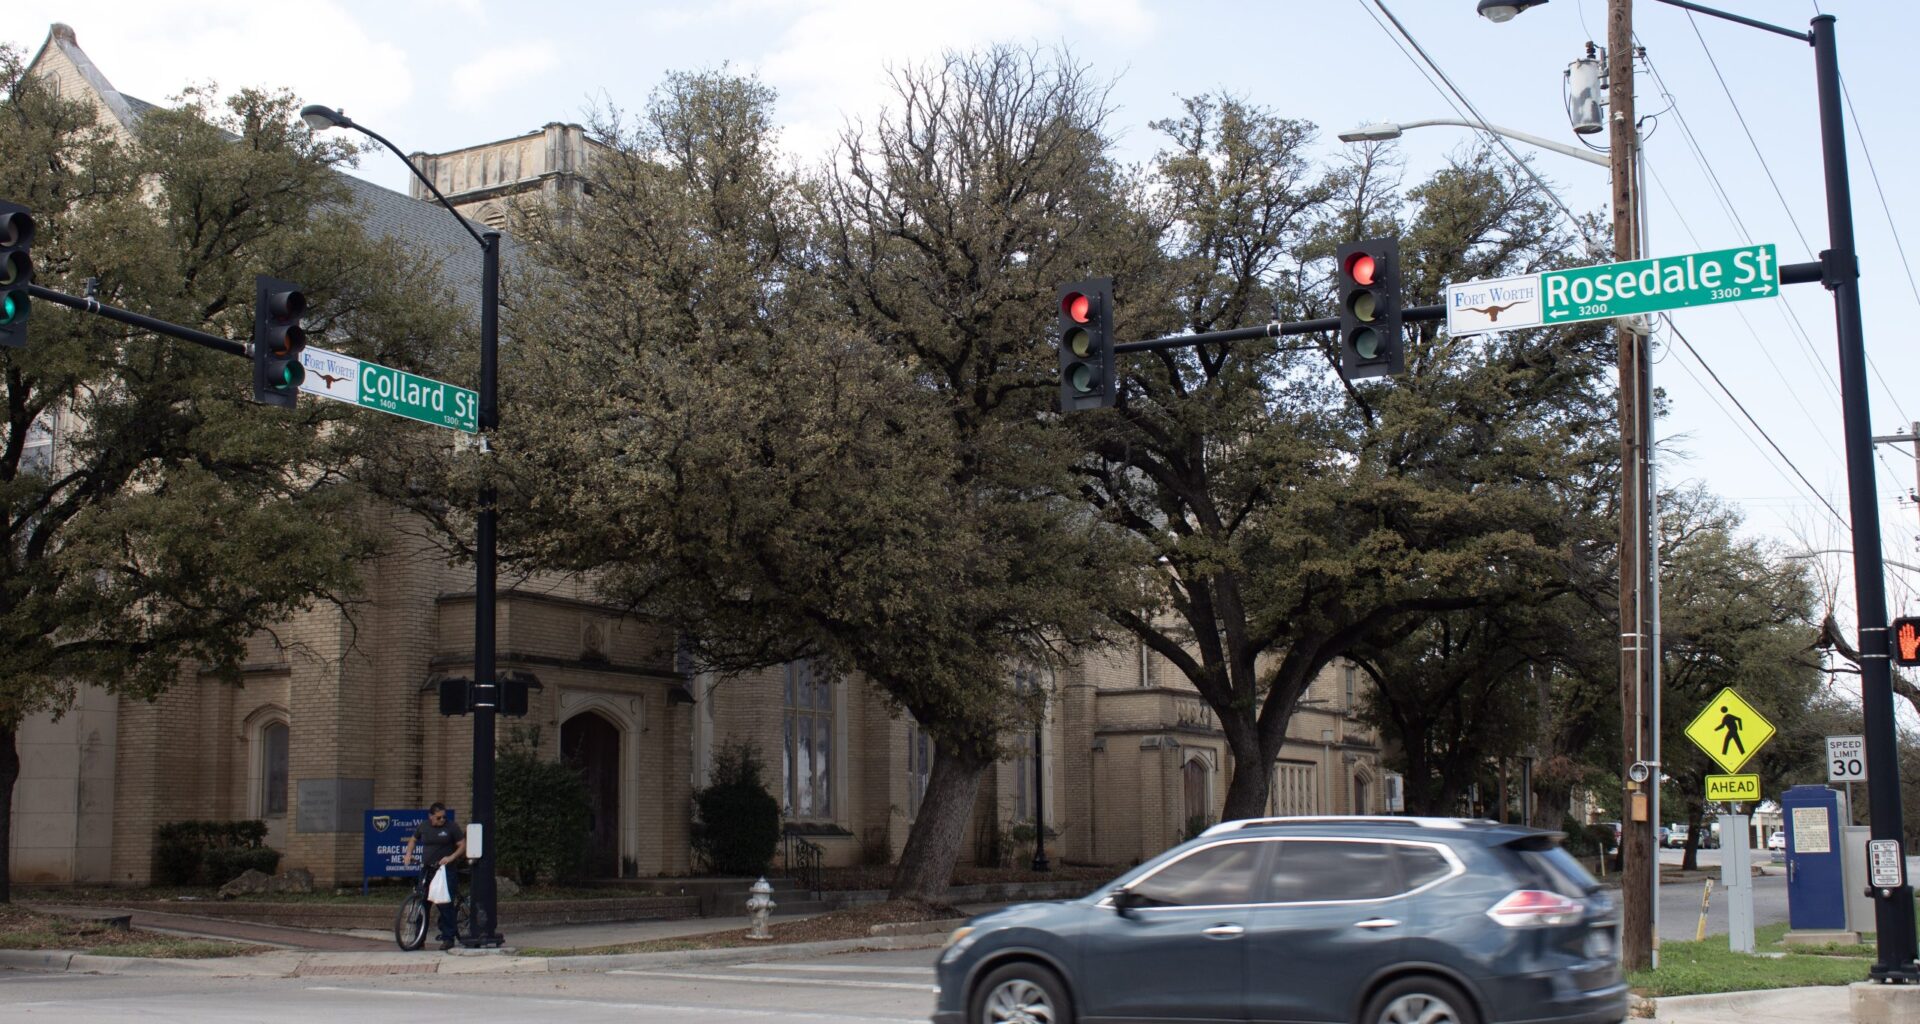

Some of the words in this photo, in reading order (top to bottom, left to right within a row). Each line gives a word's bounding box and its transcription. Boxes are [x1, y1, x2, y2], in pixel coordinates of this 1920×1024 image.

[1547, 256, 1722, 307] Rosedale
[1734, 246, 1774, 285] St
[1455, 292, 1486, 307] FORT
[1489, 287, 1534, 302] WORTH
[1711, 286, 1741, 300] 3300
[1578, 303, 1607, 316] 3200
[304, 353, 324, 371] FORT
[327, 359, 355, 379] WORTH
[363, 367, 444, 412] Collard
[455, 391, 475, 421] St
[380, 399, 397, 410] 1400
[444, 415, 459, 426] 1300
[1830, 740, 1861, 748] SPEED
[1833, 750, 1858, 758] LIMIT
[1833, 759, 1862, 776] 30
[1710, 781, 1755, 792] AHEAD
[392, 819, 412, 827] Texas
[377, 845, 400, 854] GRACE
